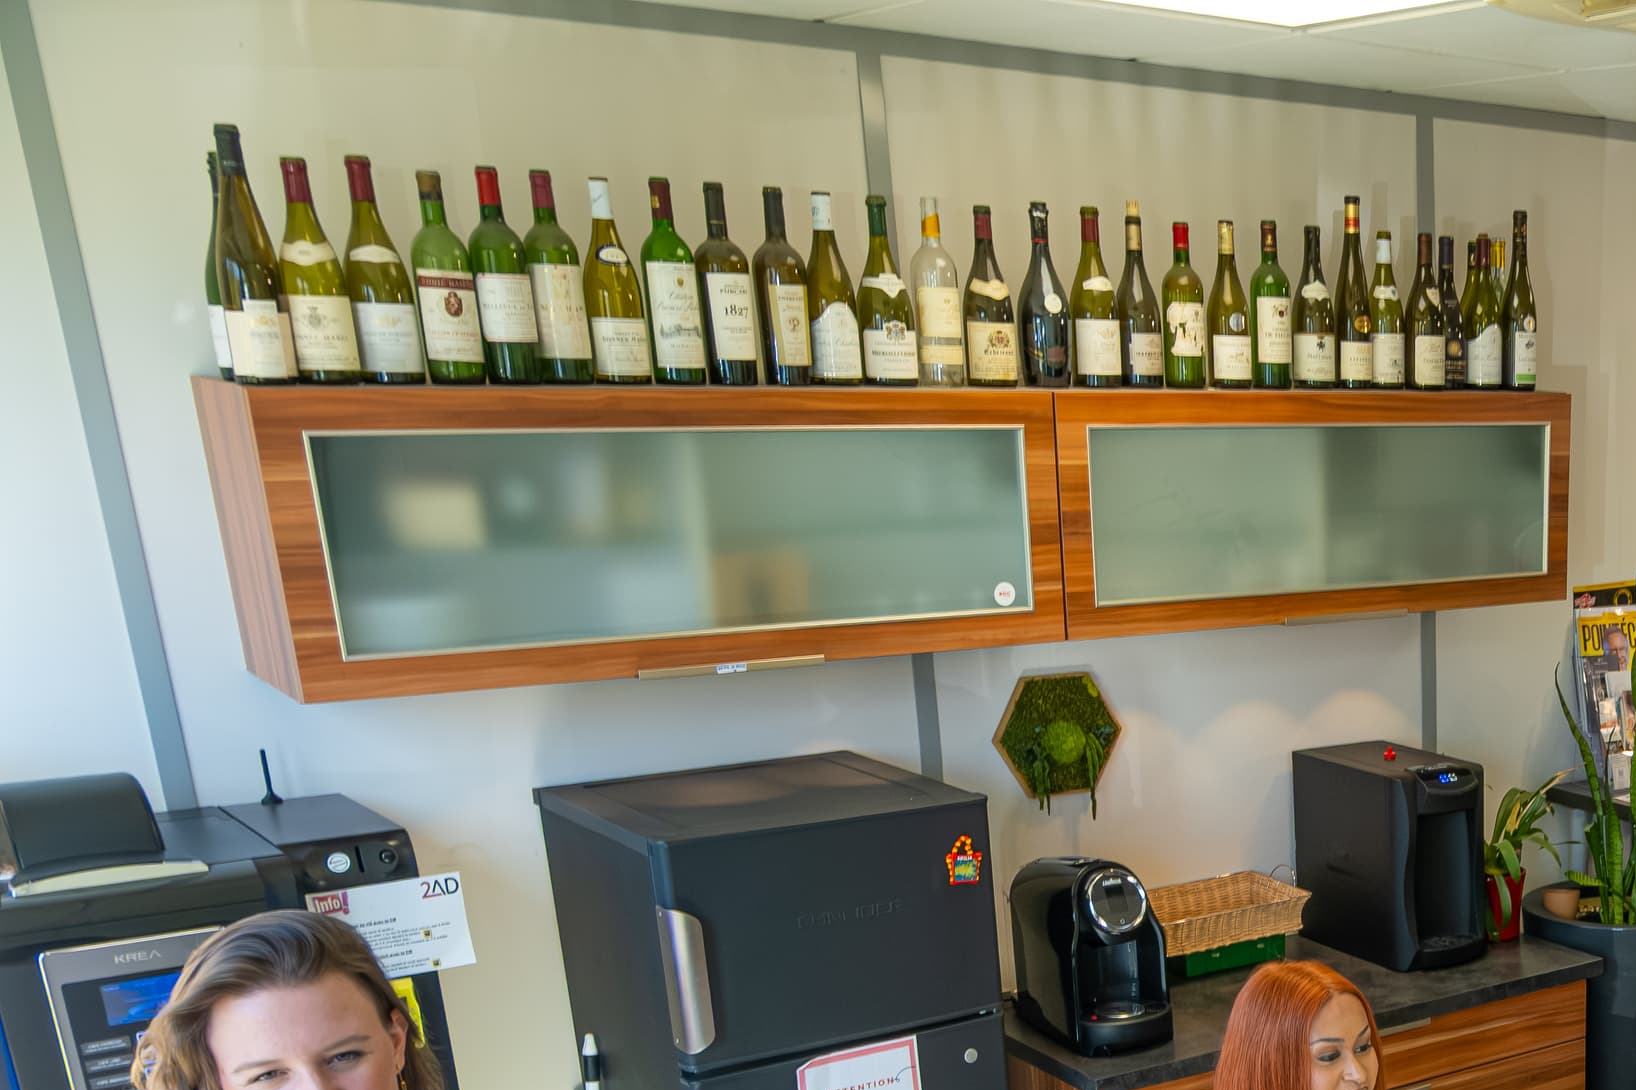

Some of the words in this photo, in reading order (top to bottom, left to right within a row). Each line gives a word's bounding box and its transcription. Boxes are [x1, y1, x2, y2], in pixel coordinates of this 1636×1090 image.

[725, 304, 749, 319] 1827
[420, 877, 459, 899] 2AD
[114, 949, 161, 965] KREA
